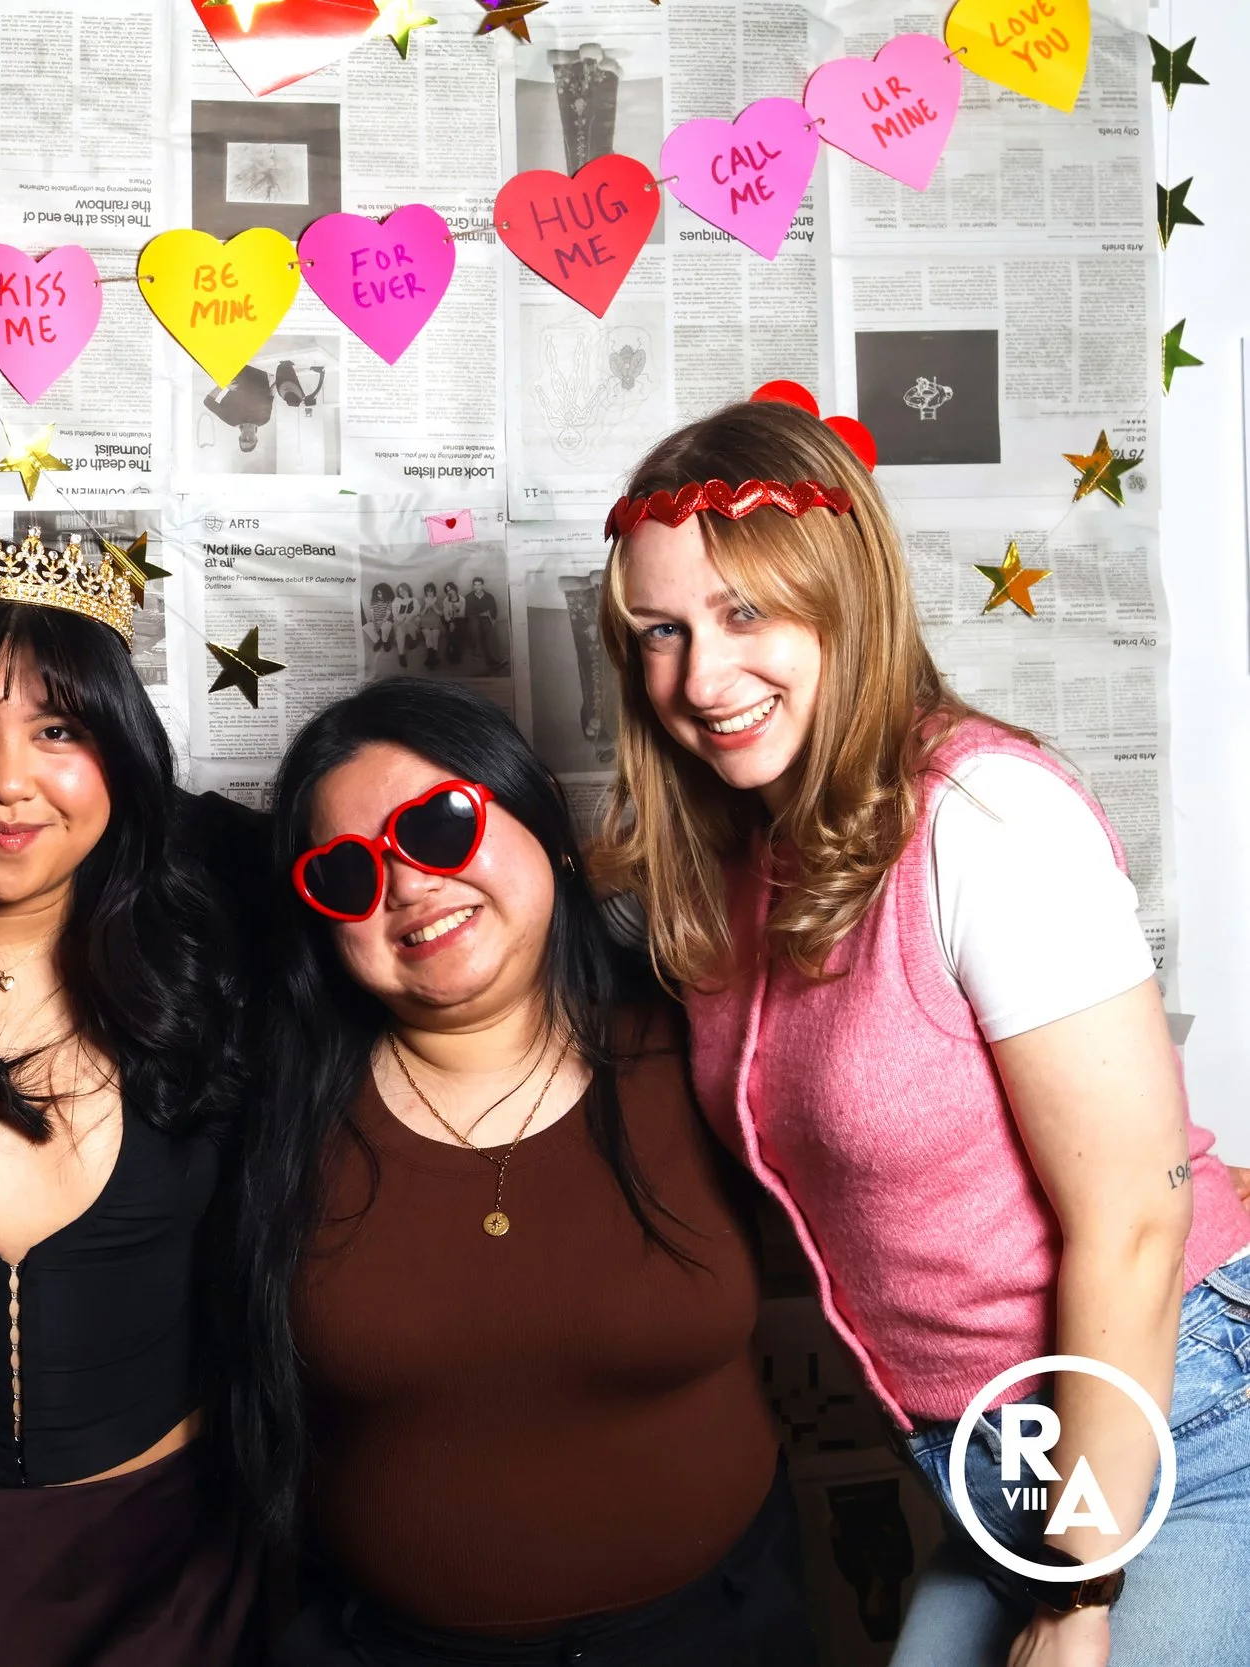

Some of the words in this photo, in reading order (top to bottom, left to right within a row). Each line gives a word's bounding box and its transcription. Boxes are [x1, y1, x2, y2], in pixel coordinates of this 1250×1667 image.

[989, 0, 1057, 48] LOVE
[1011, 28, 1071, 72] YOU
[861, 76, 912, 112] UR
[871, 98, 938, 149] MINE
[1098, 128, 1122, 136] briefs
[1124, 127, 1140, 136] City
[711, 141, 782, 185] CALL
[51, 184, 94, 193] unforgettable
[730, 175, 775, 215] ME
[75, 200, 129, 212] rainbow
[131, 201, 151, 213] the
[529, 182, 628, 241] HUG
[23, 211, 36, 224] of
[38, 212, 62, 224] end
[63, 213, 84, 226] the
[86, 214, 98, 226] at
[100, 214, 125, 227] kiss
[127, 214, 151, 227] The
[350, 244, 414, 276] FOR
[554, 234, 616, 279] ME
[194, 264, 239, 292] BE
[353, 273, 426, 308] EVER
[190, 294, 257, 328] MINE
[4, 315, 57, 346] ME
[75, 430, 106, 438] neglectful
[95, 443, 152, 459] journalist
[375, 451, 400, 459] exhibits
[437, 452, 471, 460] something
[471, 452, 483, 460] got
[75, 458, 88, 471] of
[90, 459, 126, 472] death
[128, 459, 152, 472] The
[403, 466, 436, 479] listen
[437, 467, 463, 479] and
[464, 467, 495, 479] Look
[524, 488, 538, 498] 11
[229, 519, 260, 529] ARTS
[497, 512, 504, 523] 5
[203, 543, 229, 557] ‘Not
[230, 543, 253, 557] like
[254, 544, 336, 559] GarageBand
[204, 557, 218, 568] at
[219, 557, 236, 568] all’
[204, 574, 237, 585] Synthetic
[315, 576, 344, 585] Catching
[1113, 639, 1137, 647] briefs
[1139, 637, 1157, 647] City
[1114, 752, 1137, 761] briefs
[1139, 753, 1156, 761] Arts
